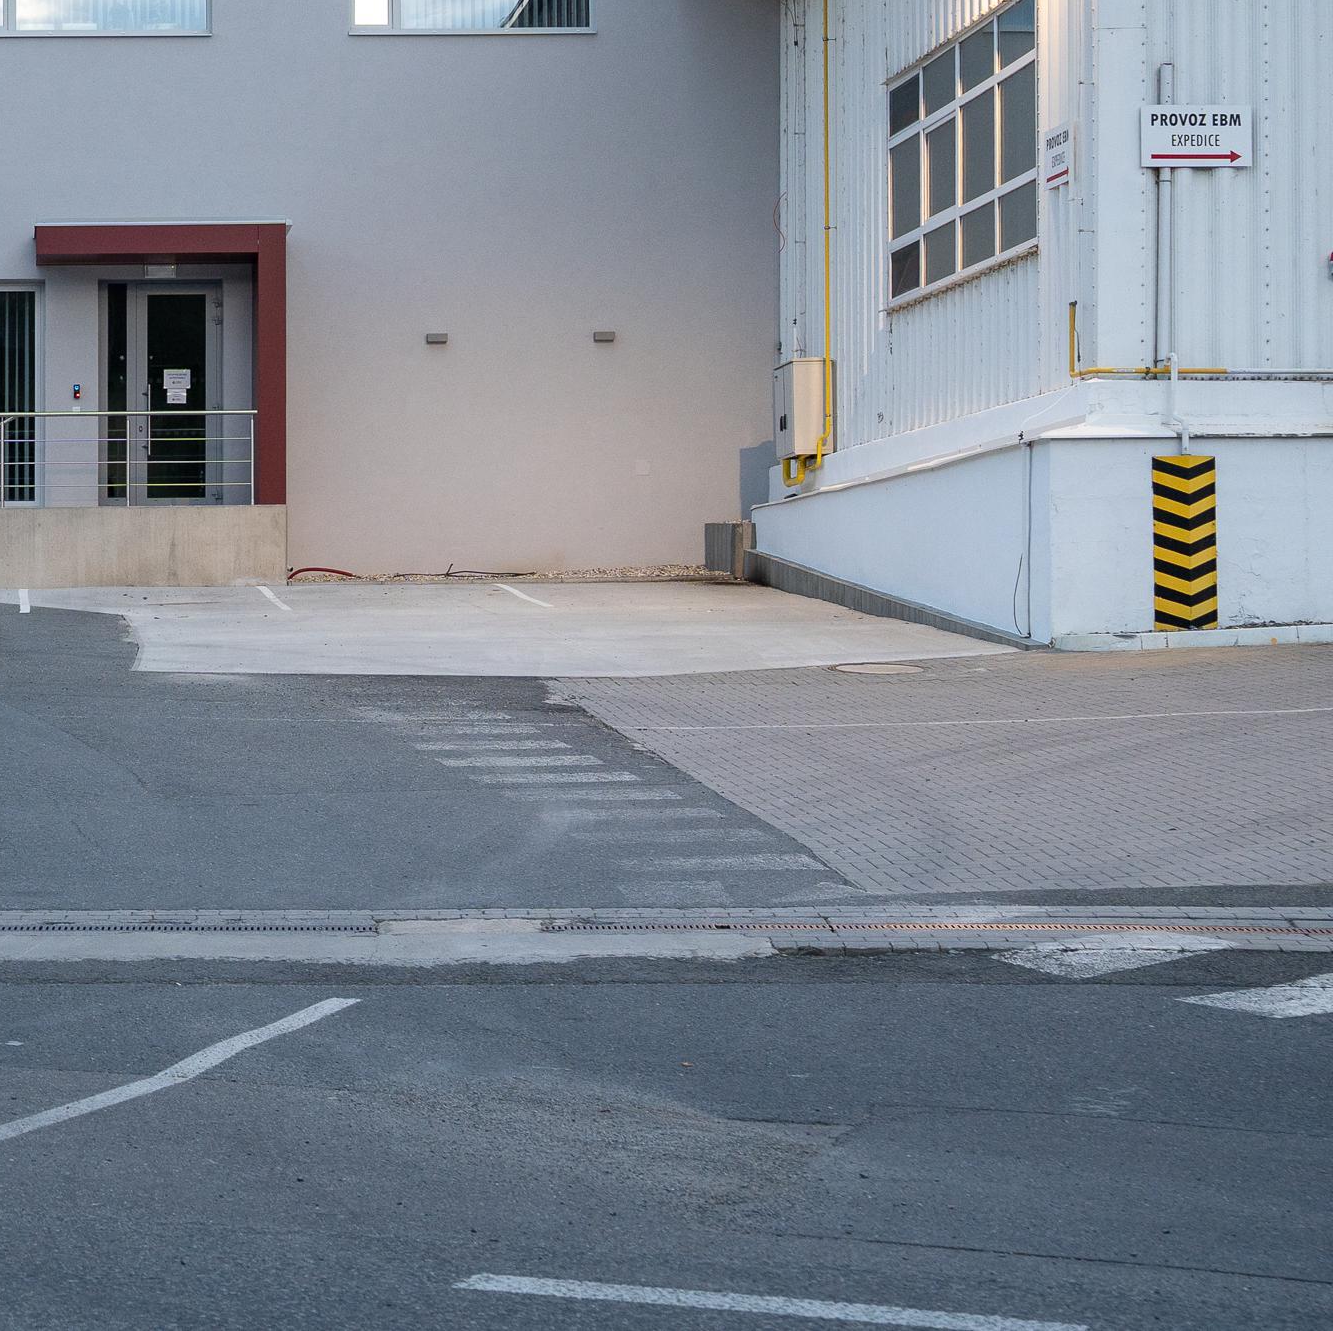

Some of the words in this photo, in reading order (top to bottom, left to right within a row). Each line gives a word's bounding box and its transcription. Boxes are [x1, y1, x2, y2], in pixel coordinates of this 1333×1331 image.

[1151, 113, 1207, 127] PROVOZ
[1212, 113, 1242, 127] EBM
[1171, 134, 1221, 147] EXPEDICE
